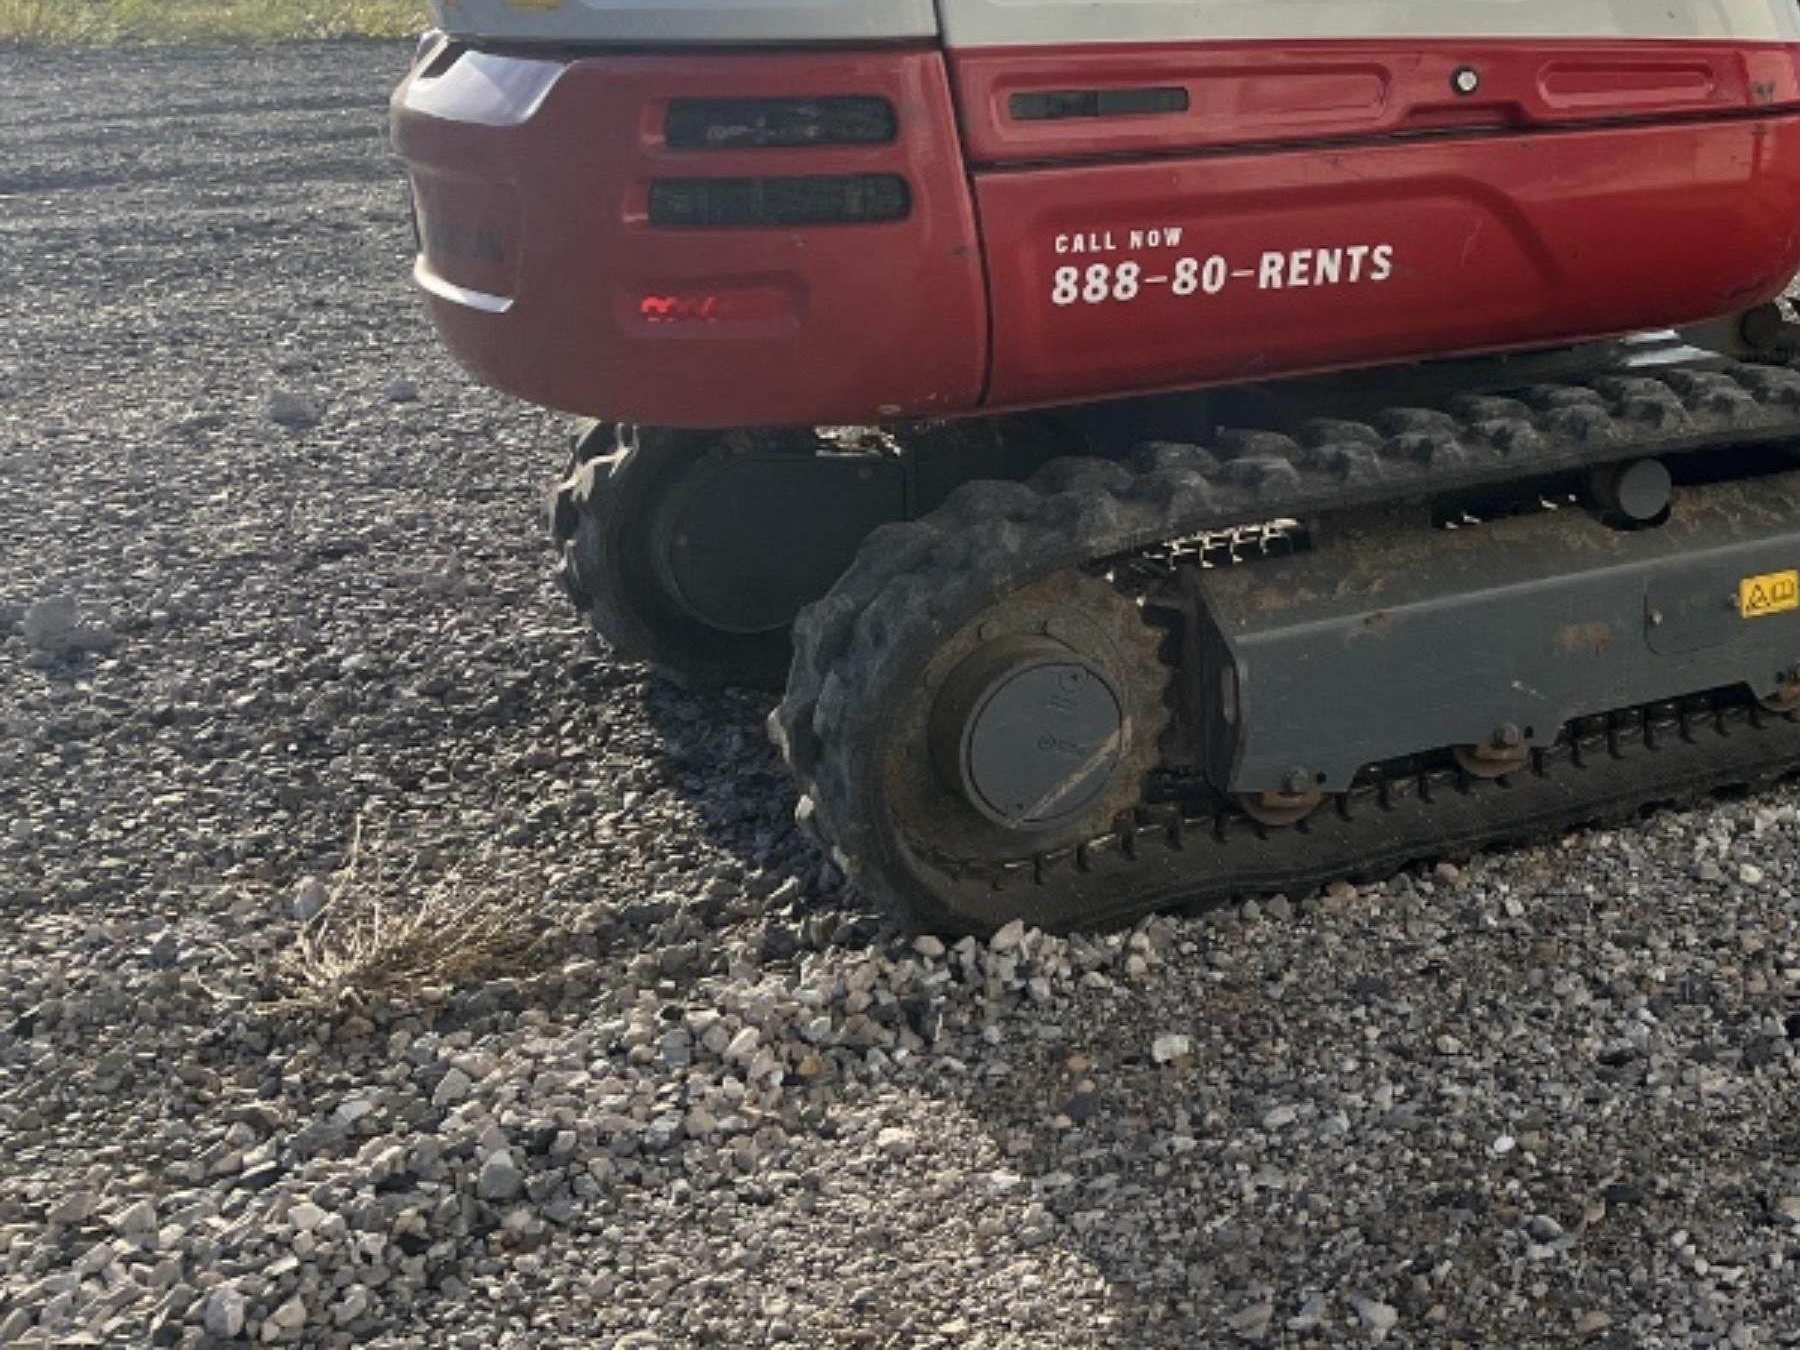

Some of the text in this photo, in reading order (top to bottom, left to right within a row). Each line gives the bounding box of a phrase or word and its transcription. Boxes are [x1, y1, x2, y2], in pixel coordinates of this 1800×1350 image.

[1055, 226, 1183, 254] CALL NOW
[1051, 243, 1394, 305] 888-80-RENTS
